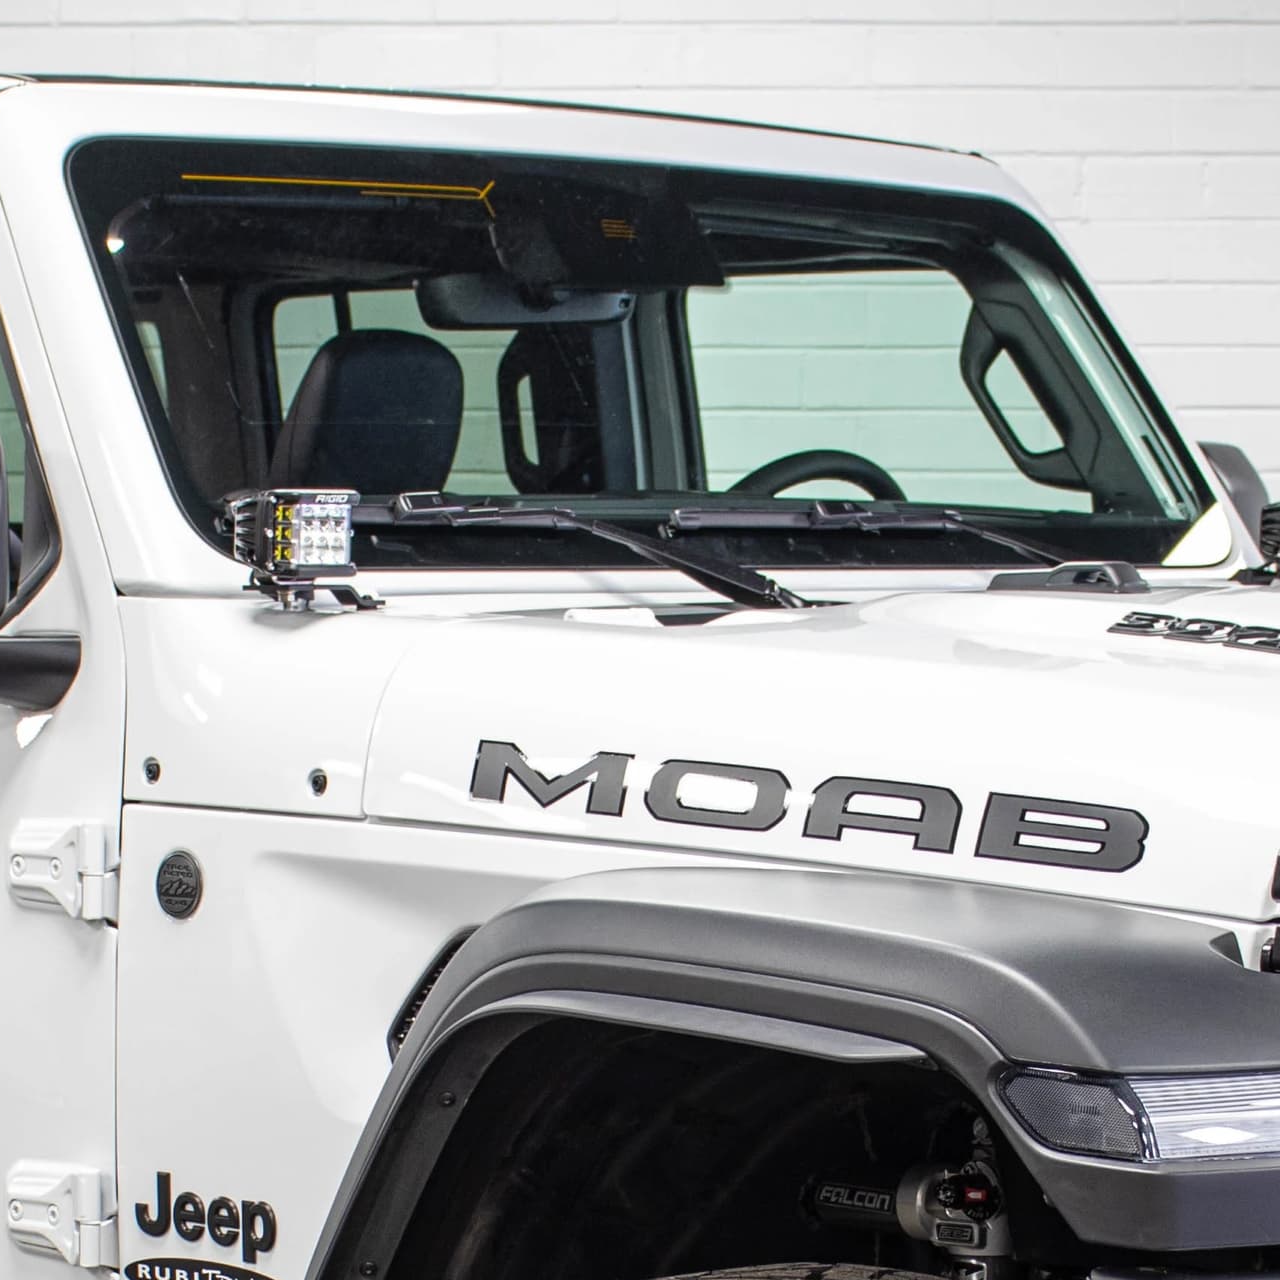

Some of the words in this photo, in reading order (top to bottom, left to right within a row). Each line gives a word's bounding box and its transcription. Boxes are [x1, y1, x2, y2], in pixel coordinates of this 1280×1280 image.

[469, 739, 1150, 874] MOAB
[135, 1171, 277, 1264] Jeep
[820, 1185, 890, 1211] FALCON
